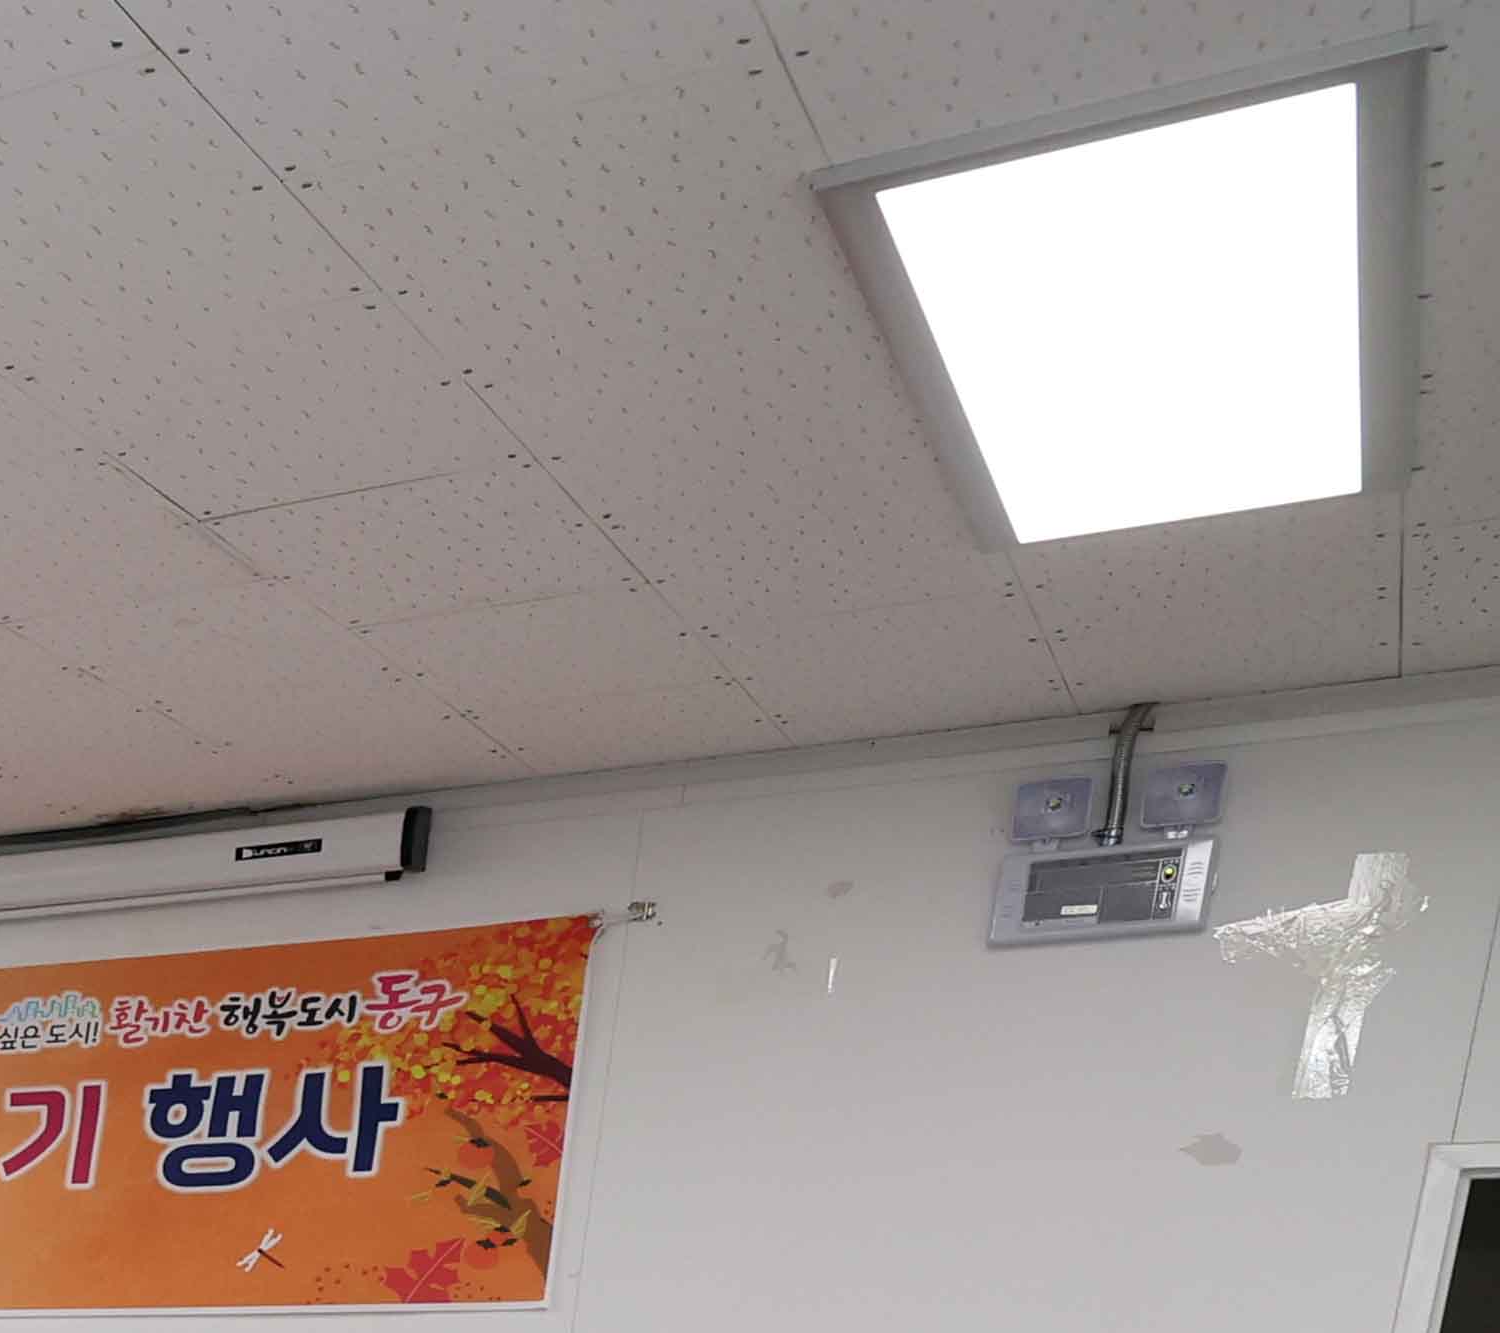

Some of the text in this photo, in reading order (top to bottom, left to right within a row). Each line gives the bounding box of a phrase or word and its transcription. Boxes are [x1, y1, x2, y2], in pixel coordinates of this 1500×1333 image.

[0, 1023, 41, 1050] 싶은
[45, 1018, 98, 1047] 도시!
[109, 1000, 210, 1044] 활기찬
[221, 989, 358, 1039] 행복도시
[365, 973, 466, 1030] 동구
[146, 1064, 400, 1190] 행사
